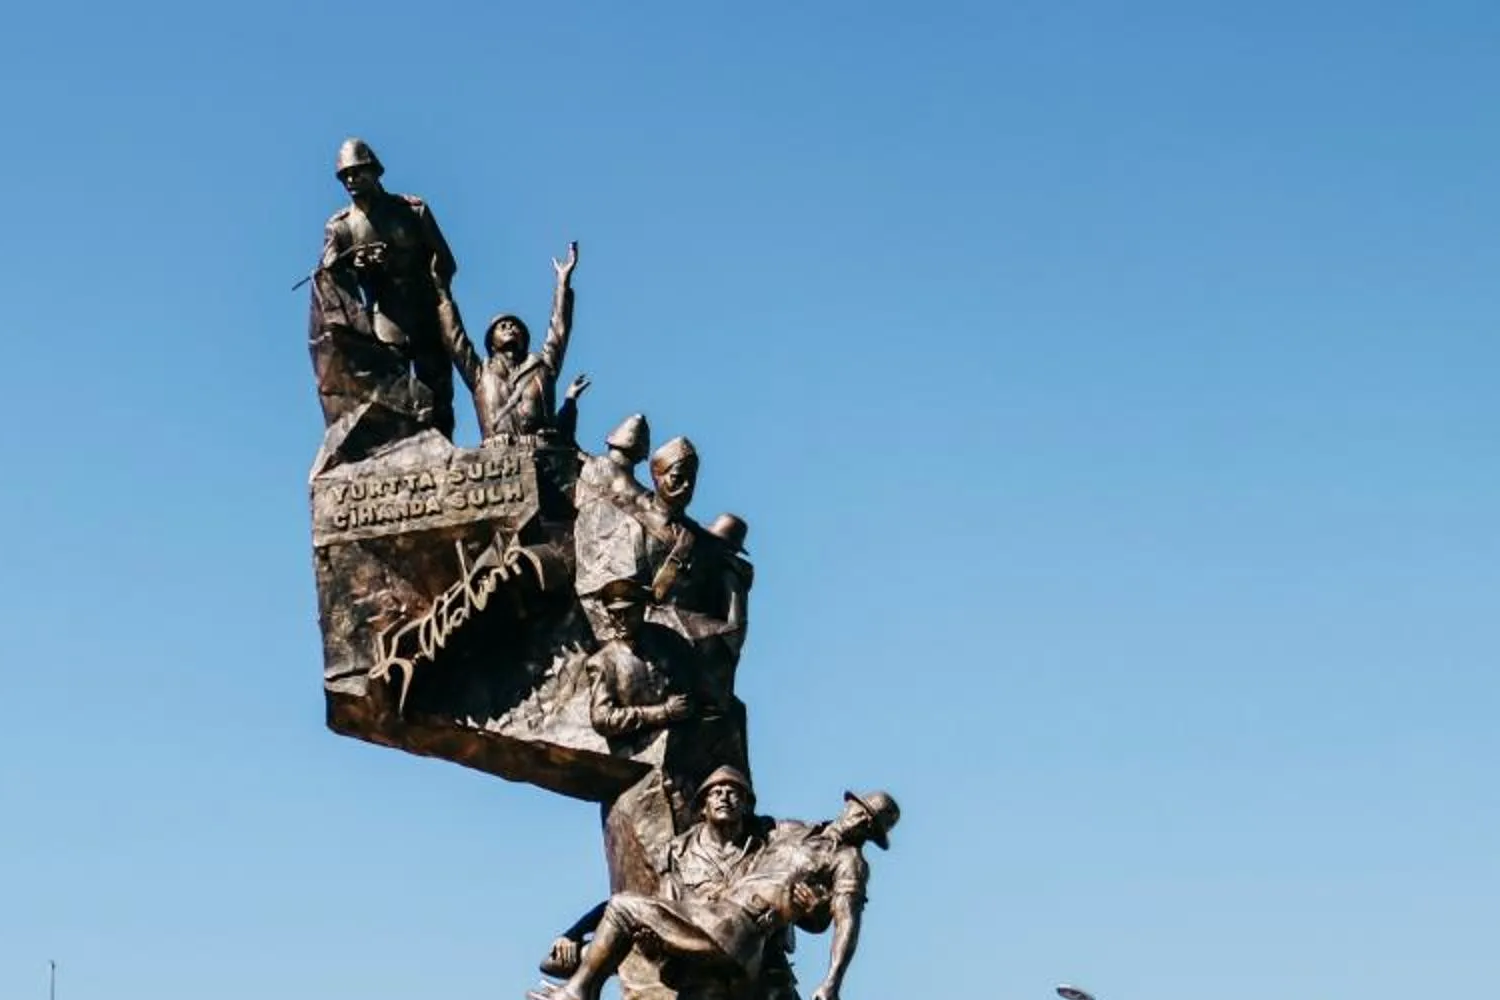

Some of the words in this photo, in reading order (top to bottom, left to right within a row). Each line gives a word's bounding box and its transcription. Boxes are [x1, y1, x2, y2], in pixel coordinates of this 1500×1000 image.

[331, 472, 437, 504] YURTTA
[449, 456, 521, 486] SULH
[451, 482, 525, 511] SULH
